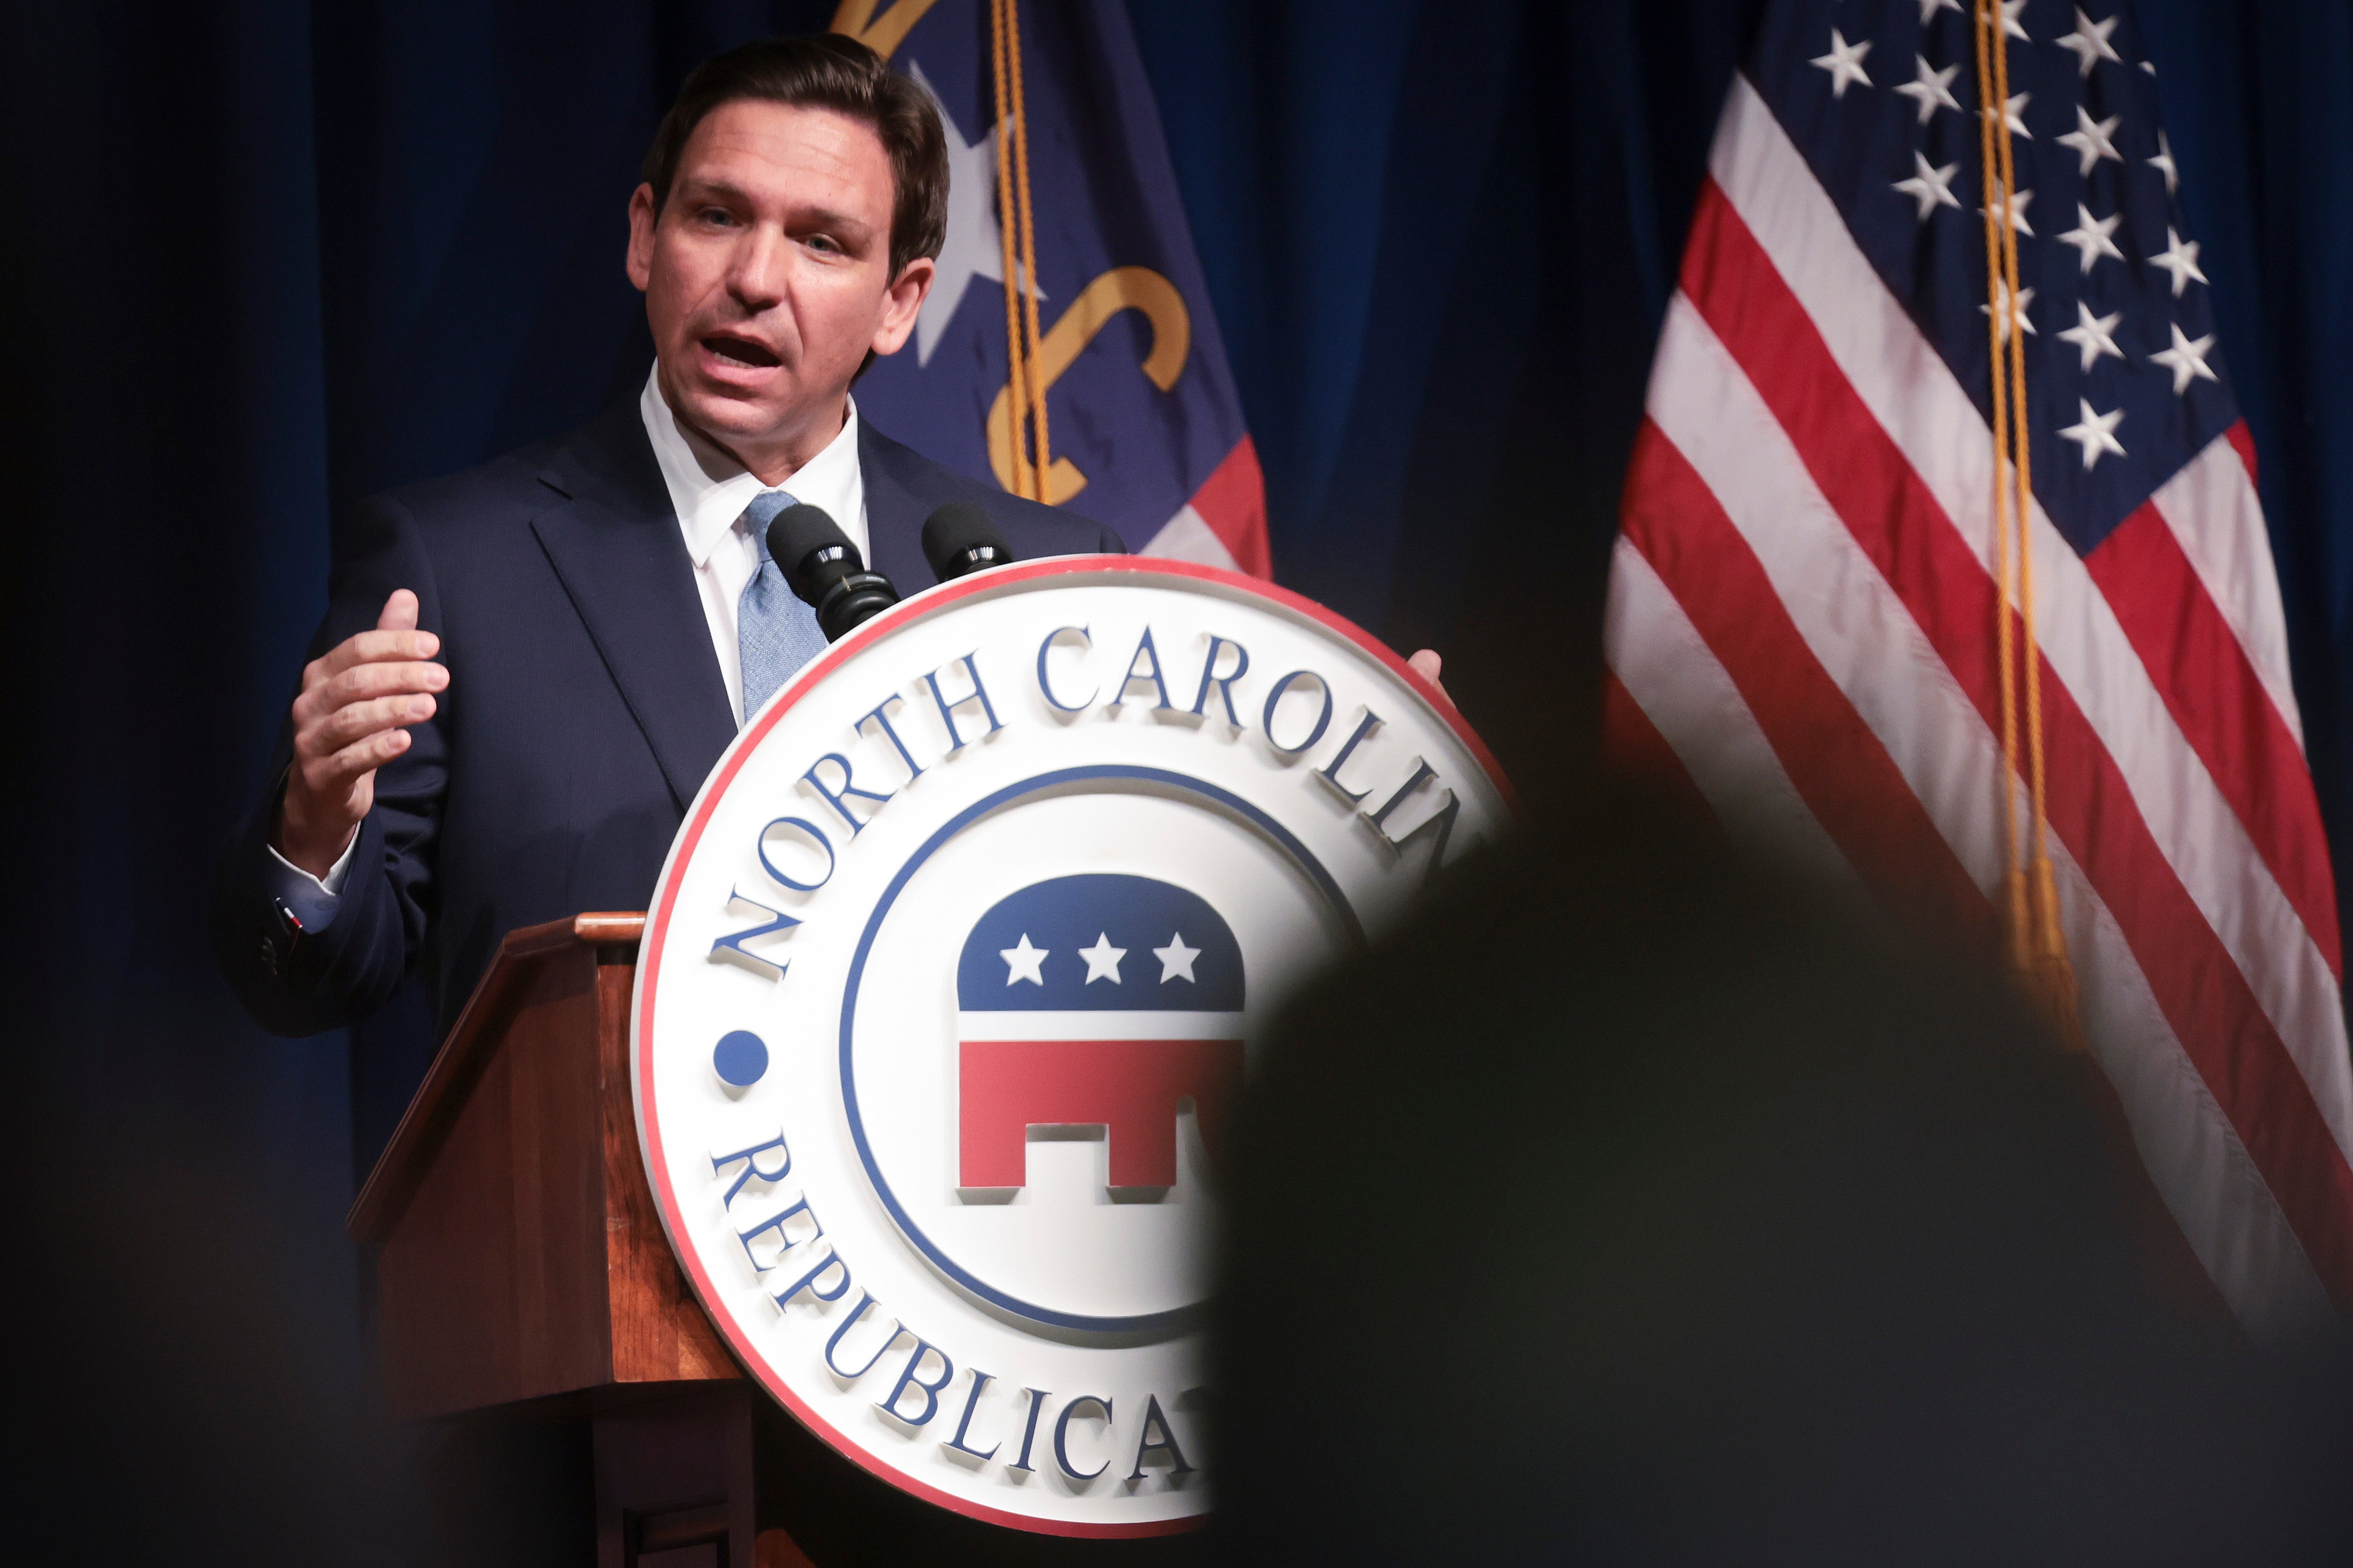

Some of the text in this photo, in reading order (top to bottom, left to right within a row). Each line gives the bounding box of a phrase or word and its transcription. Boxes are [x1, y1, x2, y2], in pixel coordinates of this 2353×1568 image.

[709, 622, 1491, 981] NORTH CAROLIN
[709, 1125, 1206, 1480] REPUBLICA
